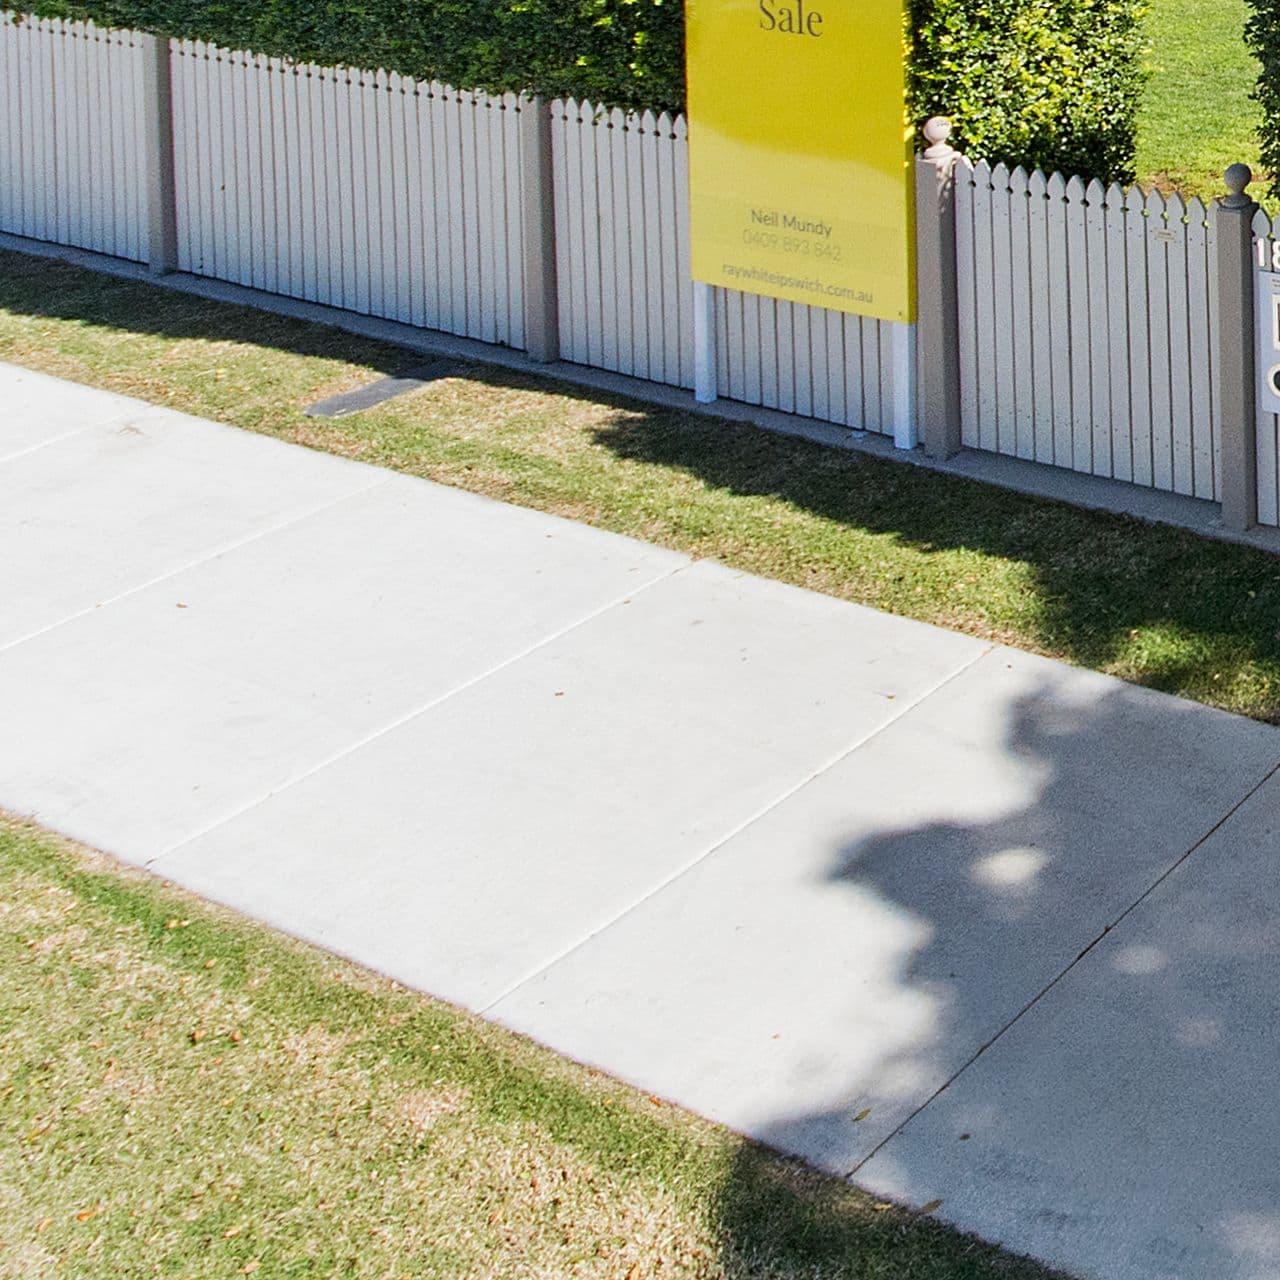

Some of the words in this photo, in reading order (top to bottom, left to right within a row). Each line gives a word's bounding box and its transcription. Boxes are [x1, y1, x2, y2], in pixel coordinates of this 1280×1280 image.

[750, 209, 779, 227] Neil
[782, 215, 833, 239] Mundy
[722, 263, 874, 303] raywhiteipswich.com.au
